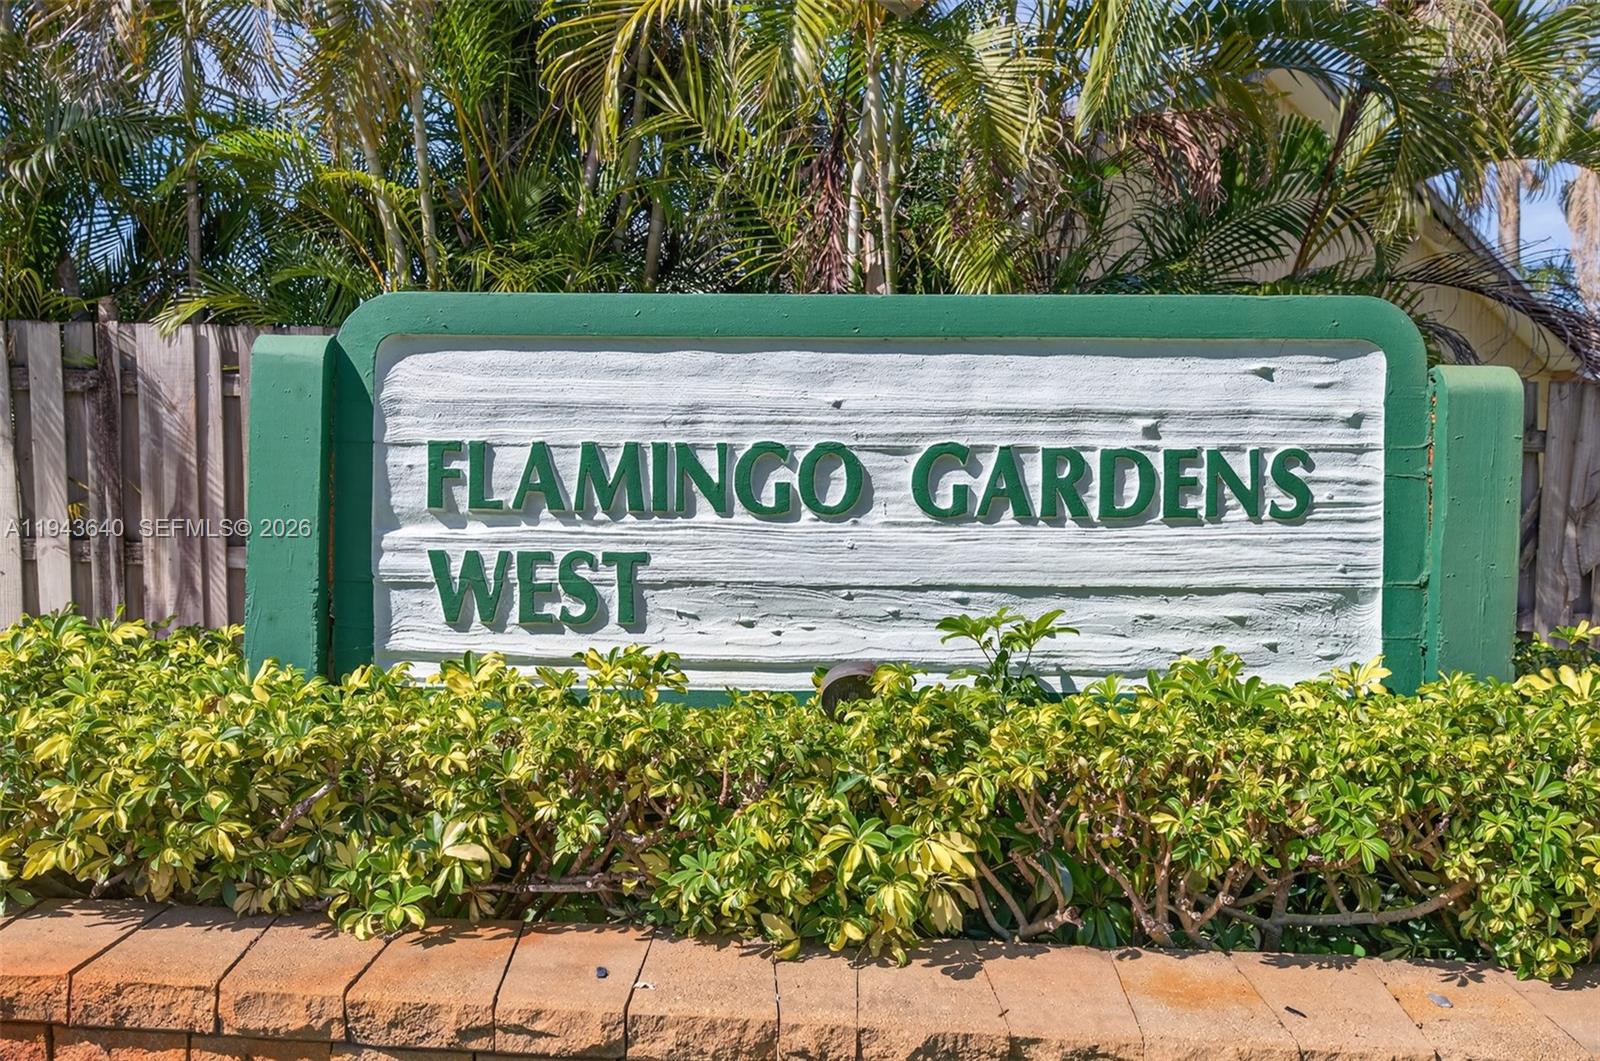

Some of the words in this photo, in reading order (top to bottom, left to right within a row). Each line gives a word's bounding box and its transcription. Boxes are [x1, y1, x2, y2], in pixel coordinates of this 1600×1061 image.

[427, 440, 866, 517] FLAMINGO
[912, 441, 1314, 520] GARDENS
[427, 549, 650, 626] WEST
